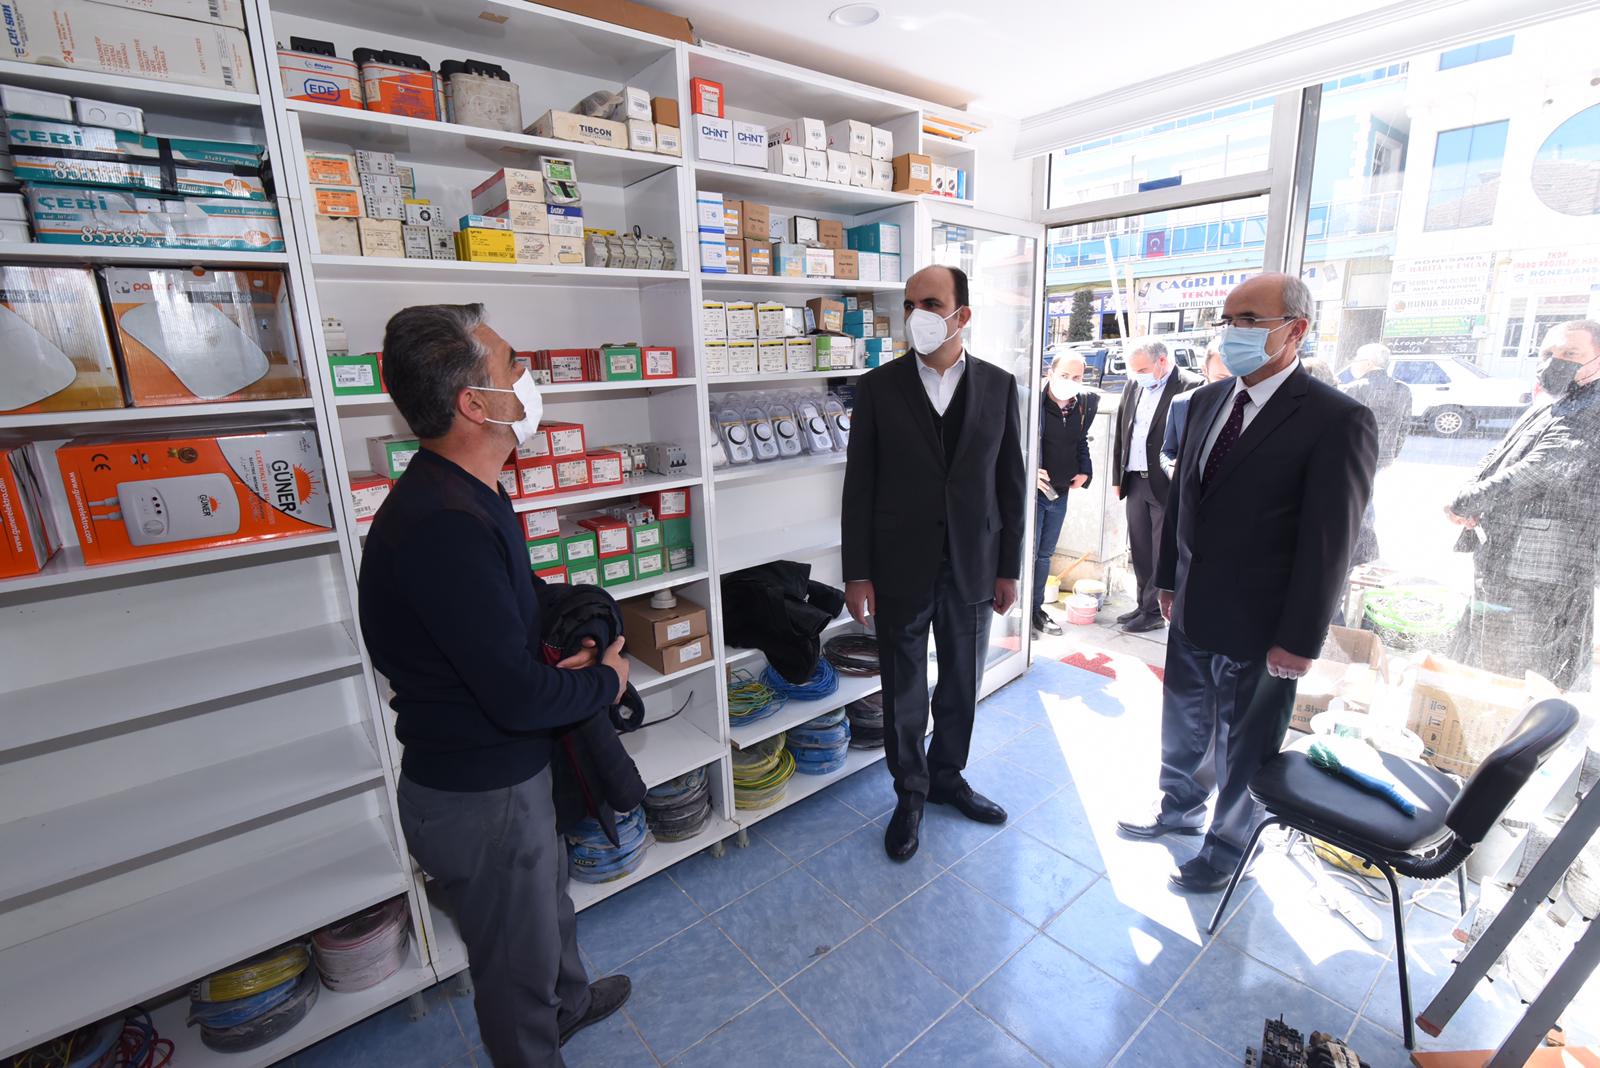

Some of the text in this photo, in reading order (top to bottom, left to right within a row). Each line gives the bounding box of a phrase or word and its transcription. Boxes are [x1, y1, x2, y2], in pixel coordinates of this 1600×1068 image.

[309, 83, 336, 97] EDE
[578, 124, 612, 137] TIBCON
[81, 225, 146, 245] 85x85
[1156, 276, 1215, 292] ÇAĞRI
[270, 459, 297, 513] GÜNER
[199, 494, 212, 517] GÜNER
